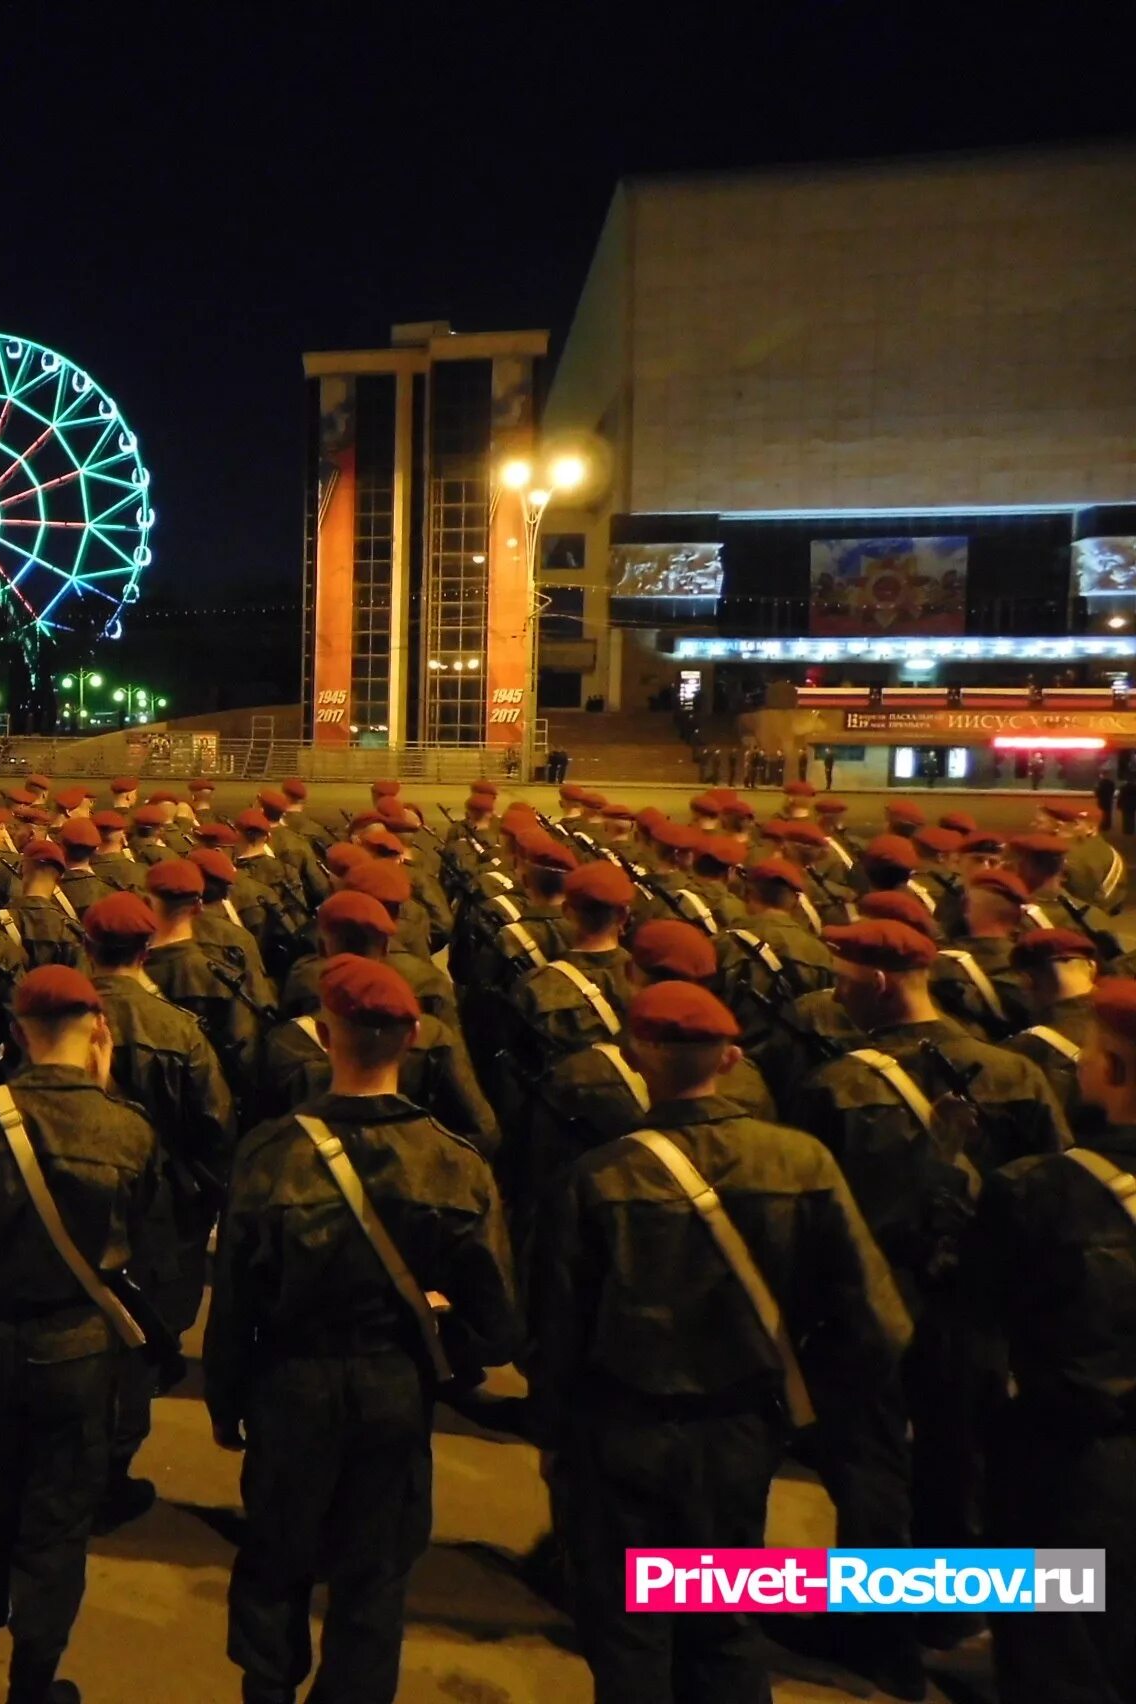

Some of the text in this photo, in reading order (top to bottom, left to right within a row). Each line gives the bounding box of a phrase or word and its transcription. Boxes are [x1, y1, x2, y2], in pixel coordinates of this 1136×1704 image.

[317, 690, 347, 704] 1945
[492, 689, 523, 704] 1945
[316, 709, 344, 724] 2017
[490, 708, 520, 723] 2017
[947, 714, 1022, 732] ИИСУС
